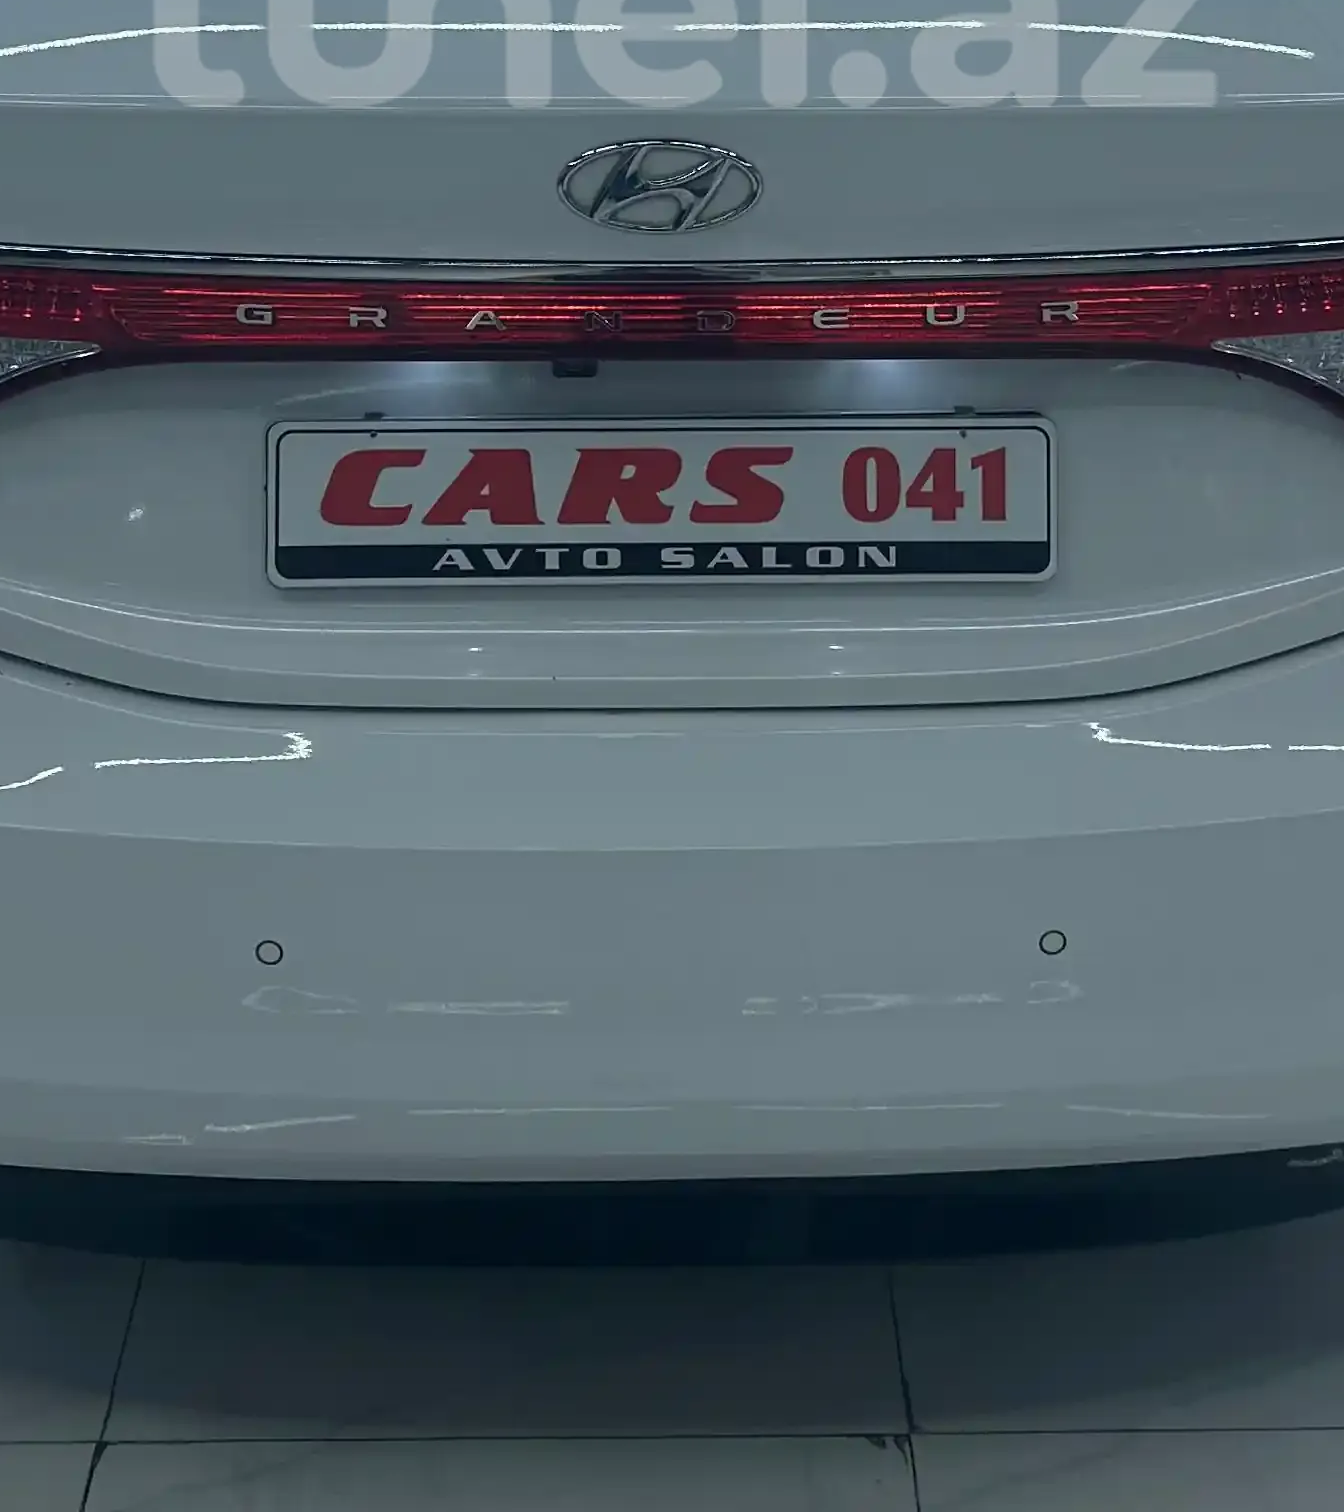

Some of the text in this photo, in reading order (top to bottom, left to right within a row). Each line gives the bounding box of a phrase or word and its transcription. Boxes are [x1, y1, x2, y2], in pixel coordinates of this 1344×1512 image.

[235, 299, 1081, 334] GRANDEUR
[319, 445, 1009, 527] CARS 041
[431, 544, 900, 572] AVTO SALON
